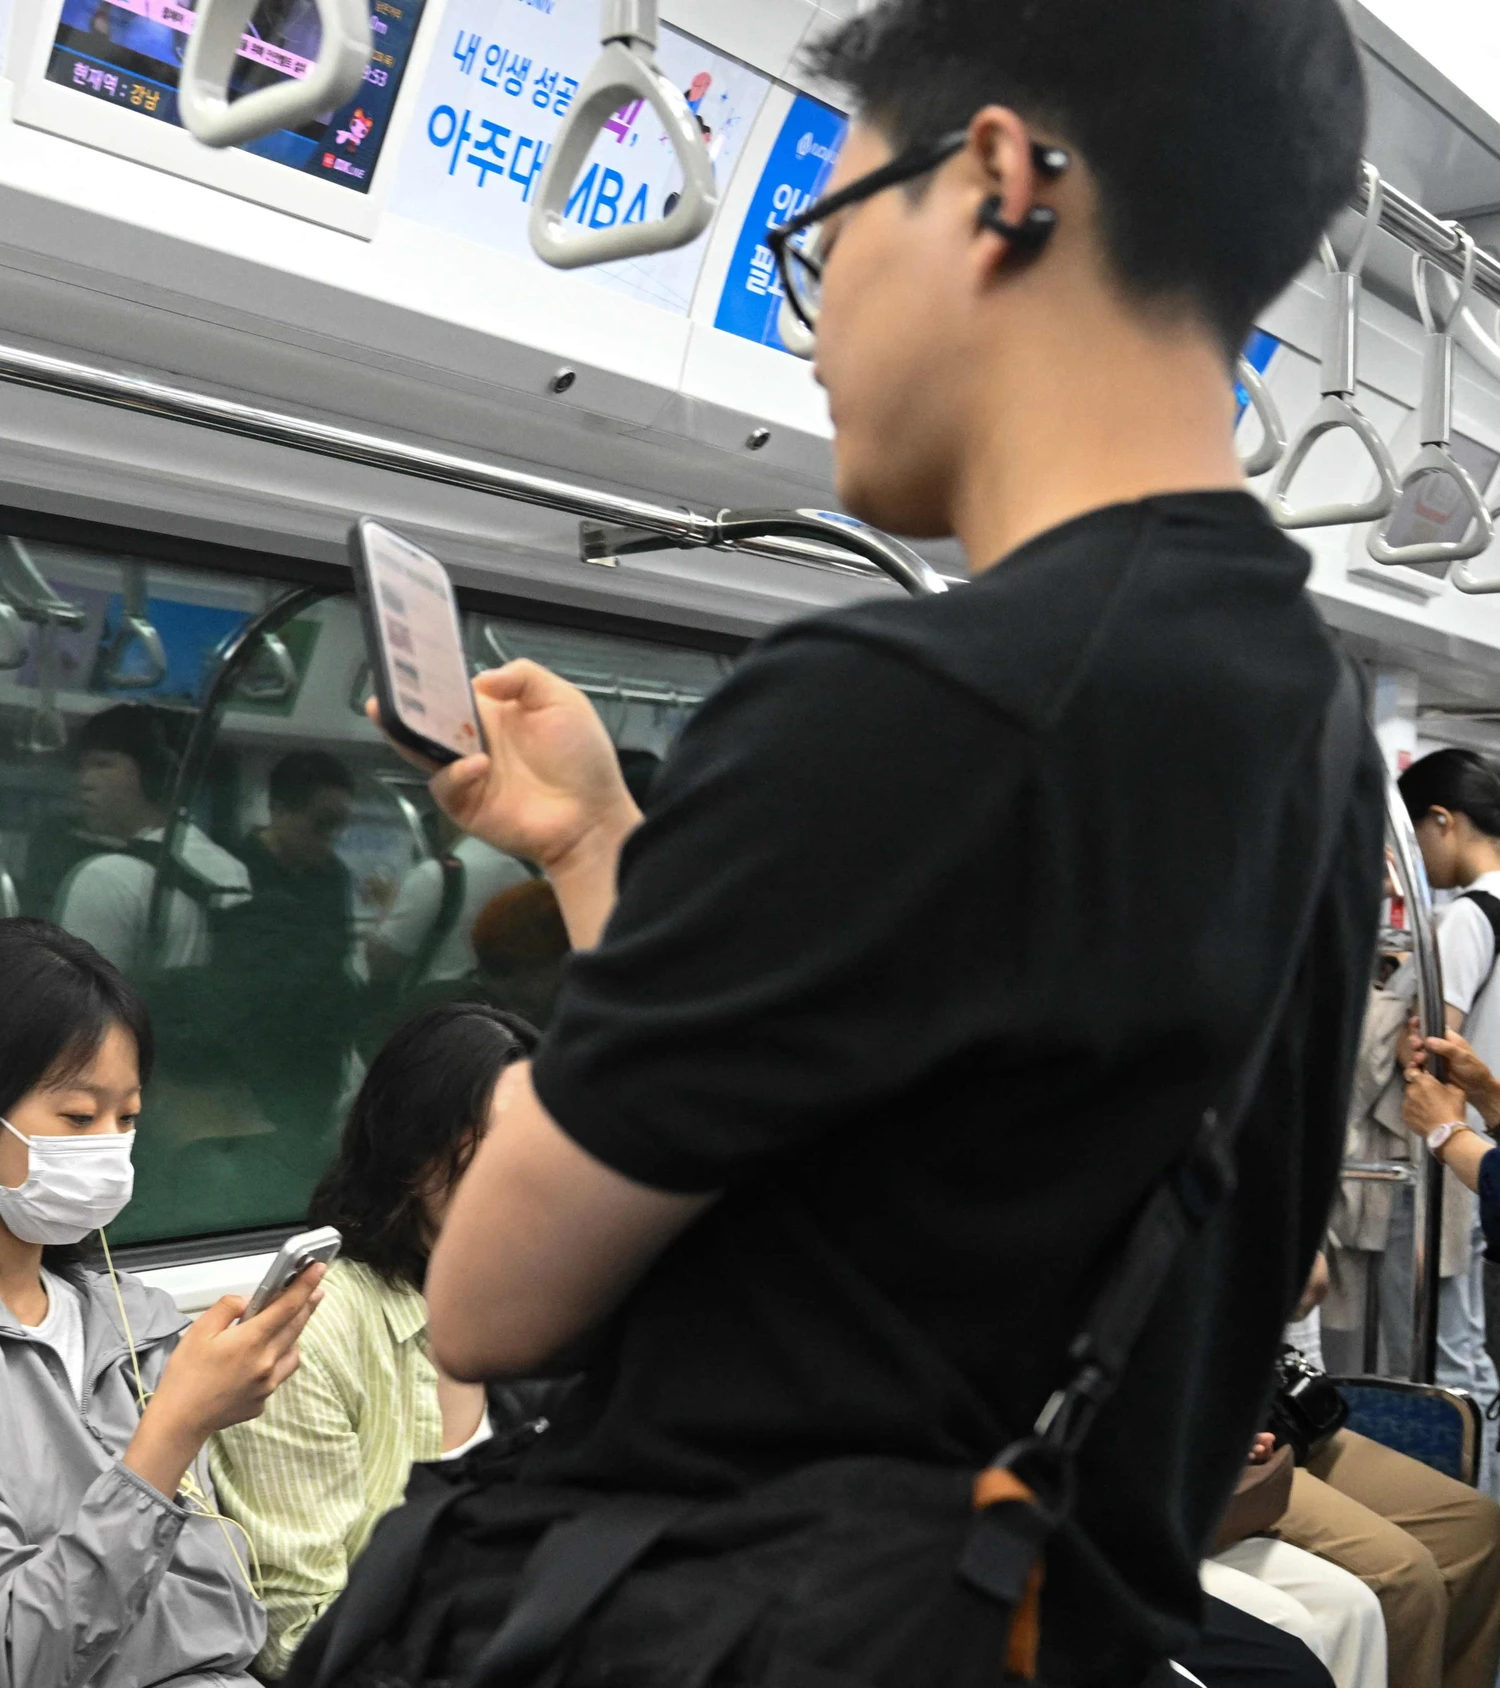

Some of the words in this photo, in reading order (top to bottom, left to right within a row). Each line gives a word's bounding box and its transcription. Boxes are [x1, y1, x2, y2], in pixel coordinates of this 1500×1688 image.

[73, 61, 119, 97] 현재역
[130, 83, 160, 111] 강남
[453, 30, 481, 75] 내
[481, 44, 532, 97] 인생
[533, 68, 579, 117] 성공
[428, 104, 552, 205] 아주대
